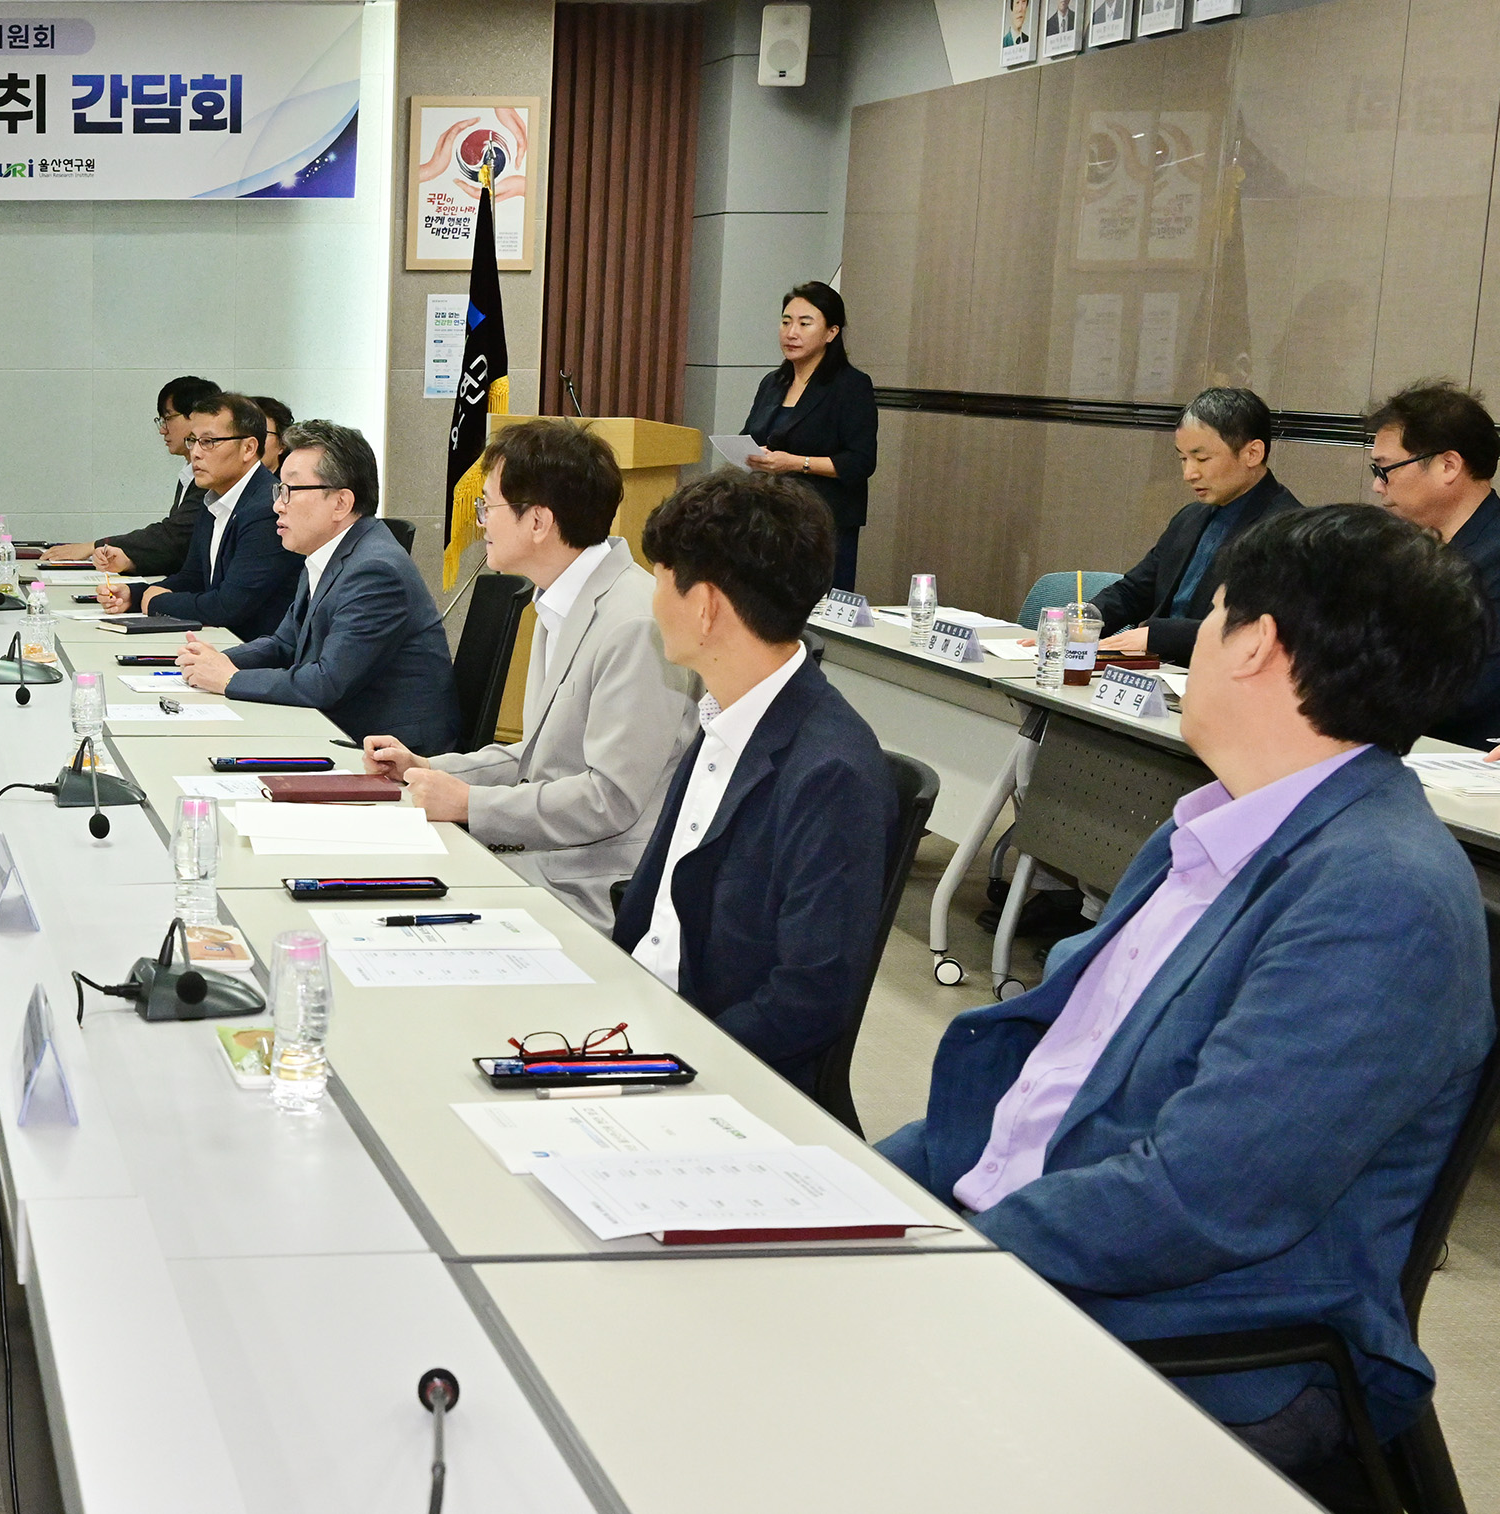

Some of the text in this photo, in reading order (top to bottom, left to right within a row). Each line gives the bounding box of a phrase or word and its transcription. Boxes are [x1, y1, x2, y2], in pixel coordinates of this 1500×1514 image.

[71, 73, 243, 134] 간담회
[38, 158, 95, 172] 울산연구원
[427, 193, 454, 205] 국민이
[436, 206, 458, 216] 주인인
[424, 215, 470, 228] 함께 행복한
[430, 227, 470, 239] 대한민국
